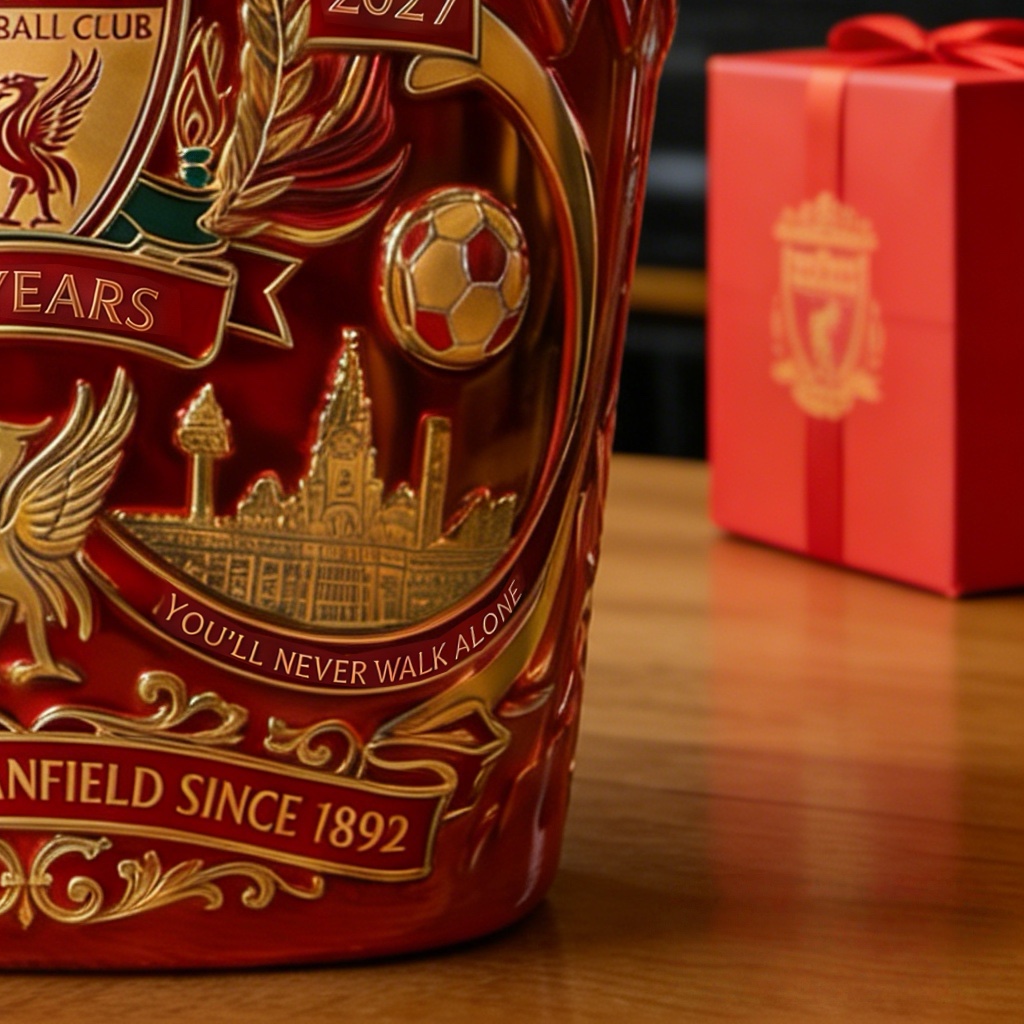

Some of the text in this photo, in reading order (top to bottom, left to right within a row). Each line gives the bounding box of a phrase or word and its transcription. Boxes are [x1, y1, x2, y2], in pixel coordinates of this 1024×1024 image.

[72, 14, 153, 39] CLUB
[165, 578, 524, 685] YOU'LL NEVER WALK ALONE
[176, 773, 303, 837] SINCE
[313, 802, 409, 853] 1892
